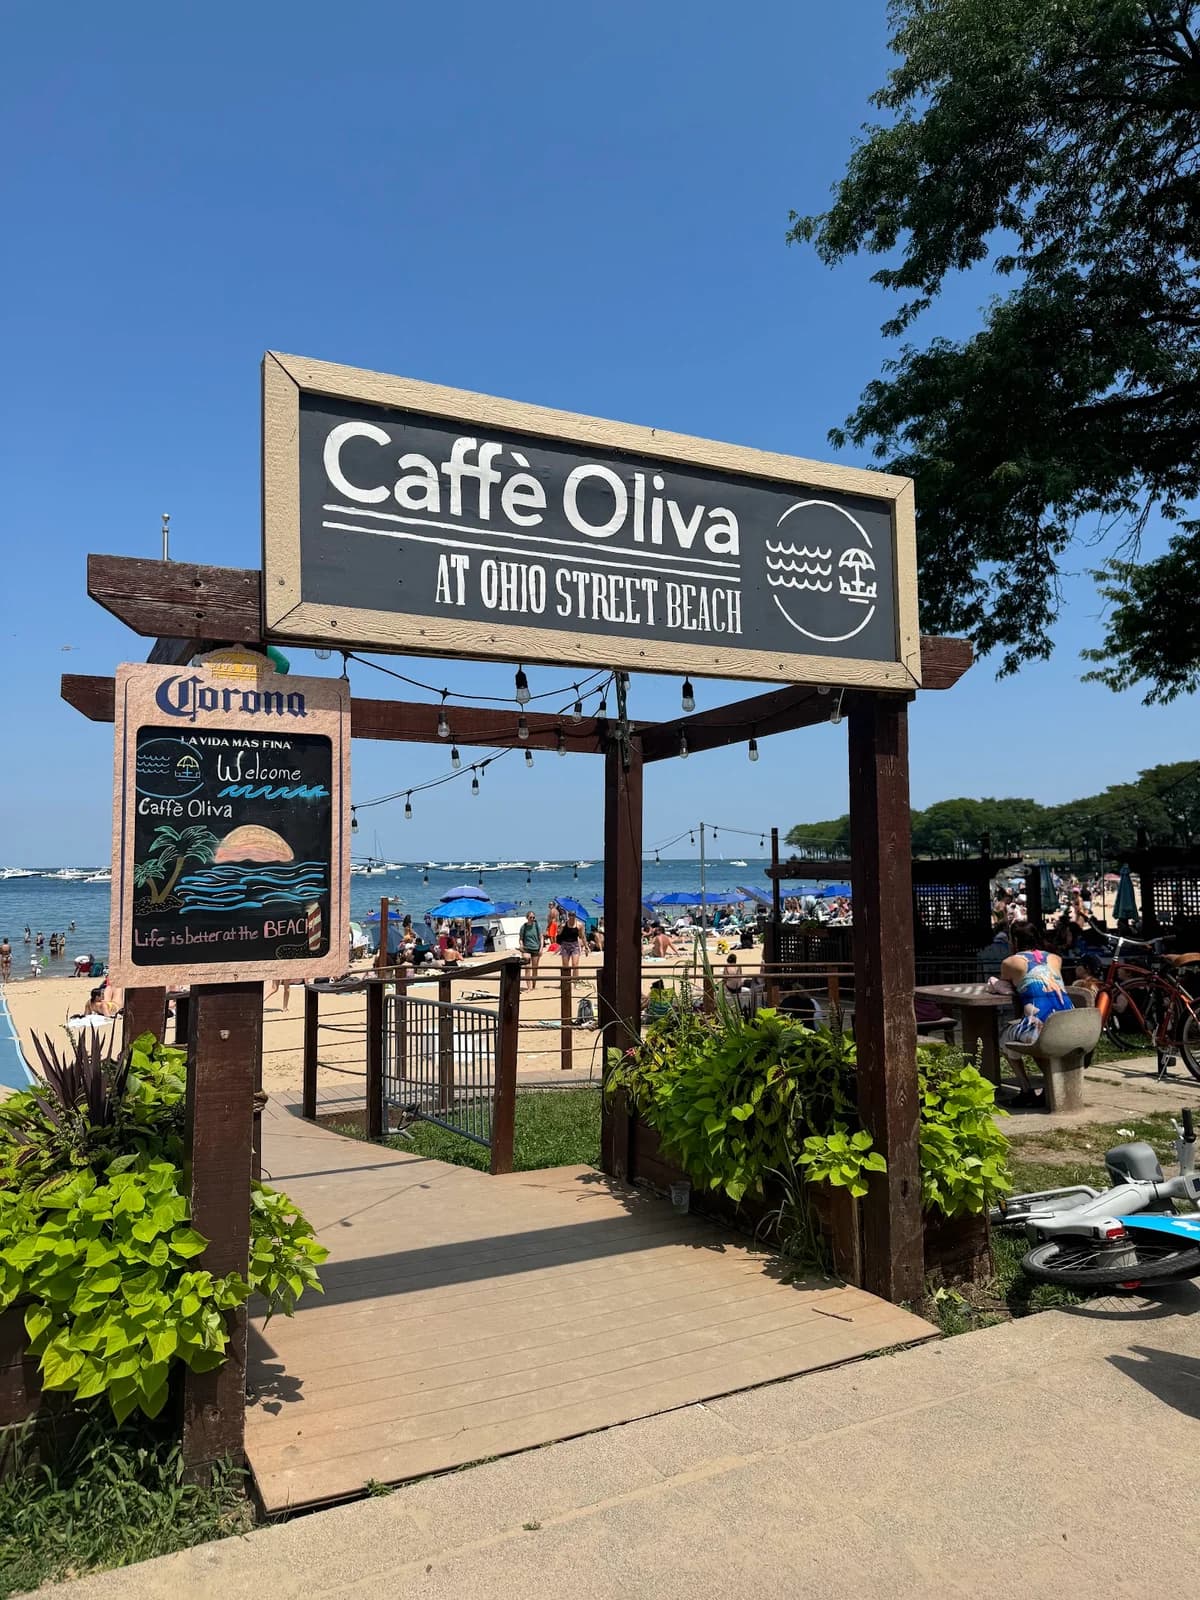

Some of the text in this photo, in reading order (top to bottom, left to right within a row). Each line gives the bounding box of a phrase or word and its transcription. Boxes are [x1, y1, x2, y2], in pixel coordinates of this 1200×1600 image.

[323, 421, 740, 555] Caffè Oliva
[435, 554, 743, 634] AT OHIO STREET BEACH
[155, 675, 308, 722] Corona
[180, 736, 291, 750] LA VIDA MÁS FINA
[217, 750, 302, 783] Welcome
[138, 797, 233, 818] Caffè Oliva
[134, 928, 166, 948] Life
[170, 931, 184, 945] is
[185, 926, 221, 945] better
[222, 927, 239, 941] at
[239, 925, 259, 941] the
